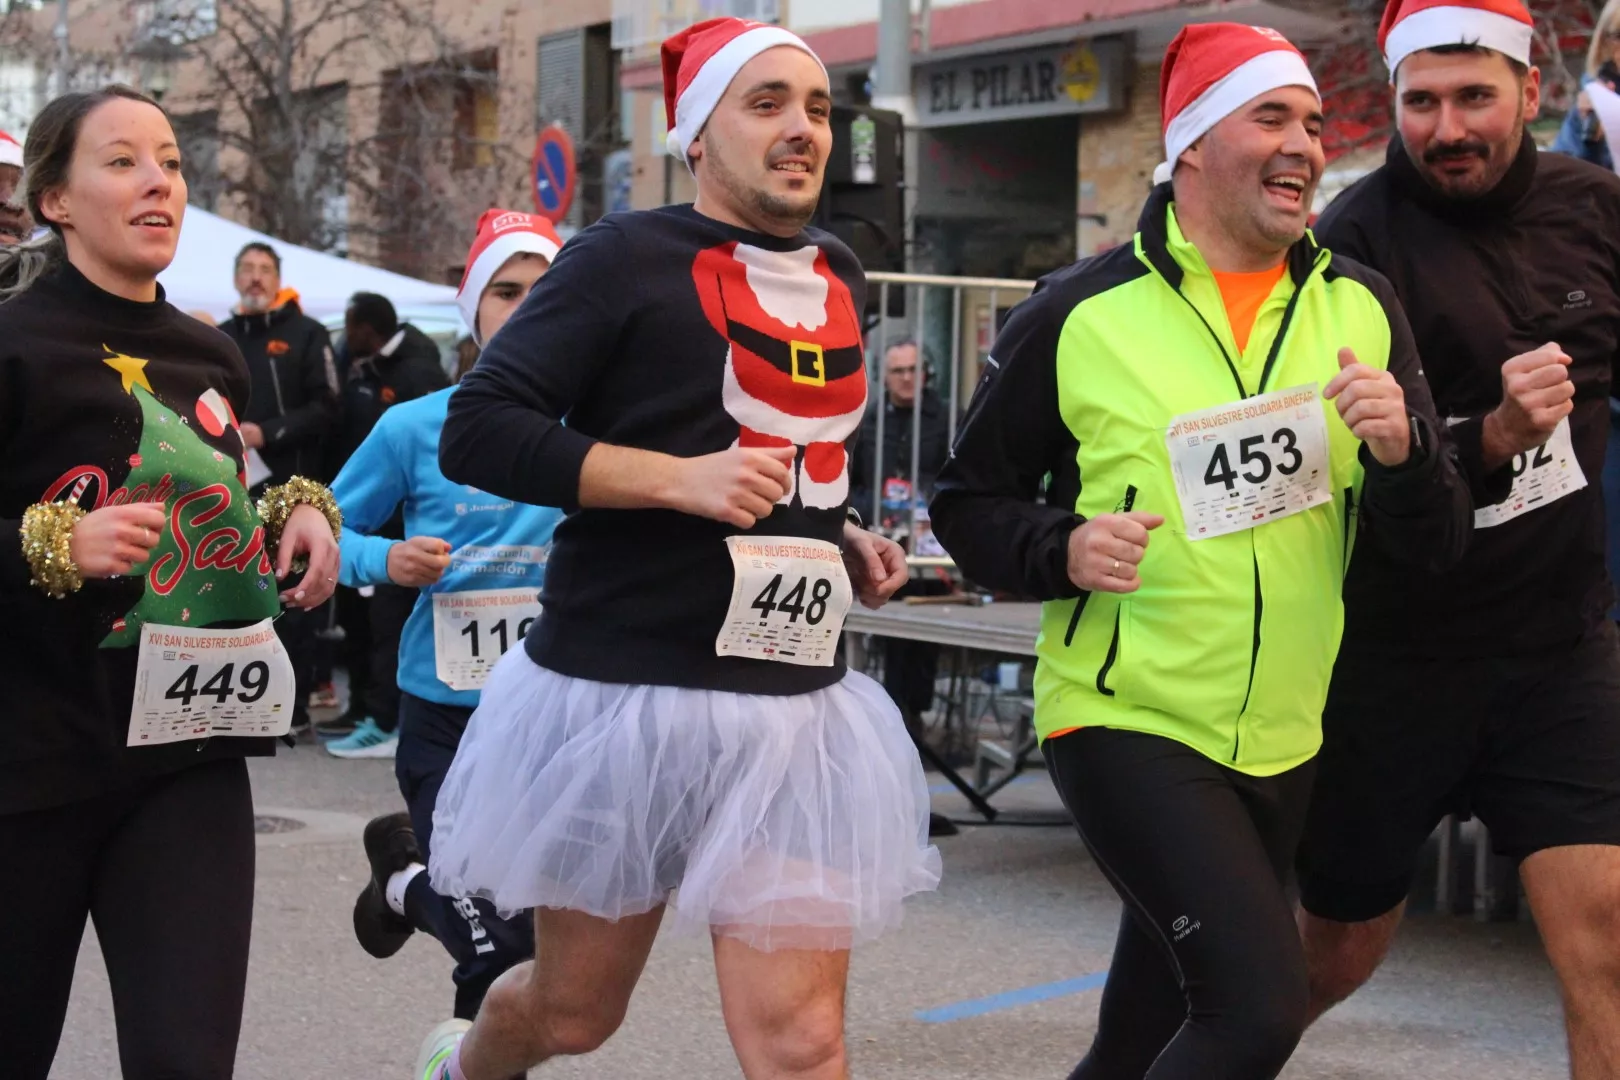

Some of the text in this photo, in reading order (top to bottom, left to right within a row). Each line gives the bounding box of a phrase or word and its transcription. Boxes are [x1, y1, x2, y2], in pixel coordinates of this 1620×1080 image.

[929, 71, 961, 114] EL
[970, 60, 1057, 110] PILAR
[1184, 421, 1200, 434] SAN
[1201, 409, 1243, 430] SILVESTRE
[1245, 399, 1283, 420] SOLIDARIA
[1204, 427, 1303, 491] 453
[748, 544, 763, 556] SAN
[765, 545, 801, 558] SILVESTRE
[802, 547, 828, 561] SOLIDARIA
[451, 597, 464, 608] SAN
[465, 595, 498, 608] SILVESTRE
[500, 594, 532, 606] SOLIDARIA
[751, 574, 832, 625] 448
[148, 632, 162, 645] XVI
[164, 634, 182, 647] SAN
[184, 635, 228, 649] SILVESTRE
[229, 632, 264, 648] SOLIDARIA
[164, 660, 270, 706] 449
